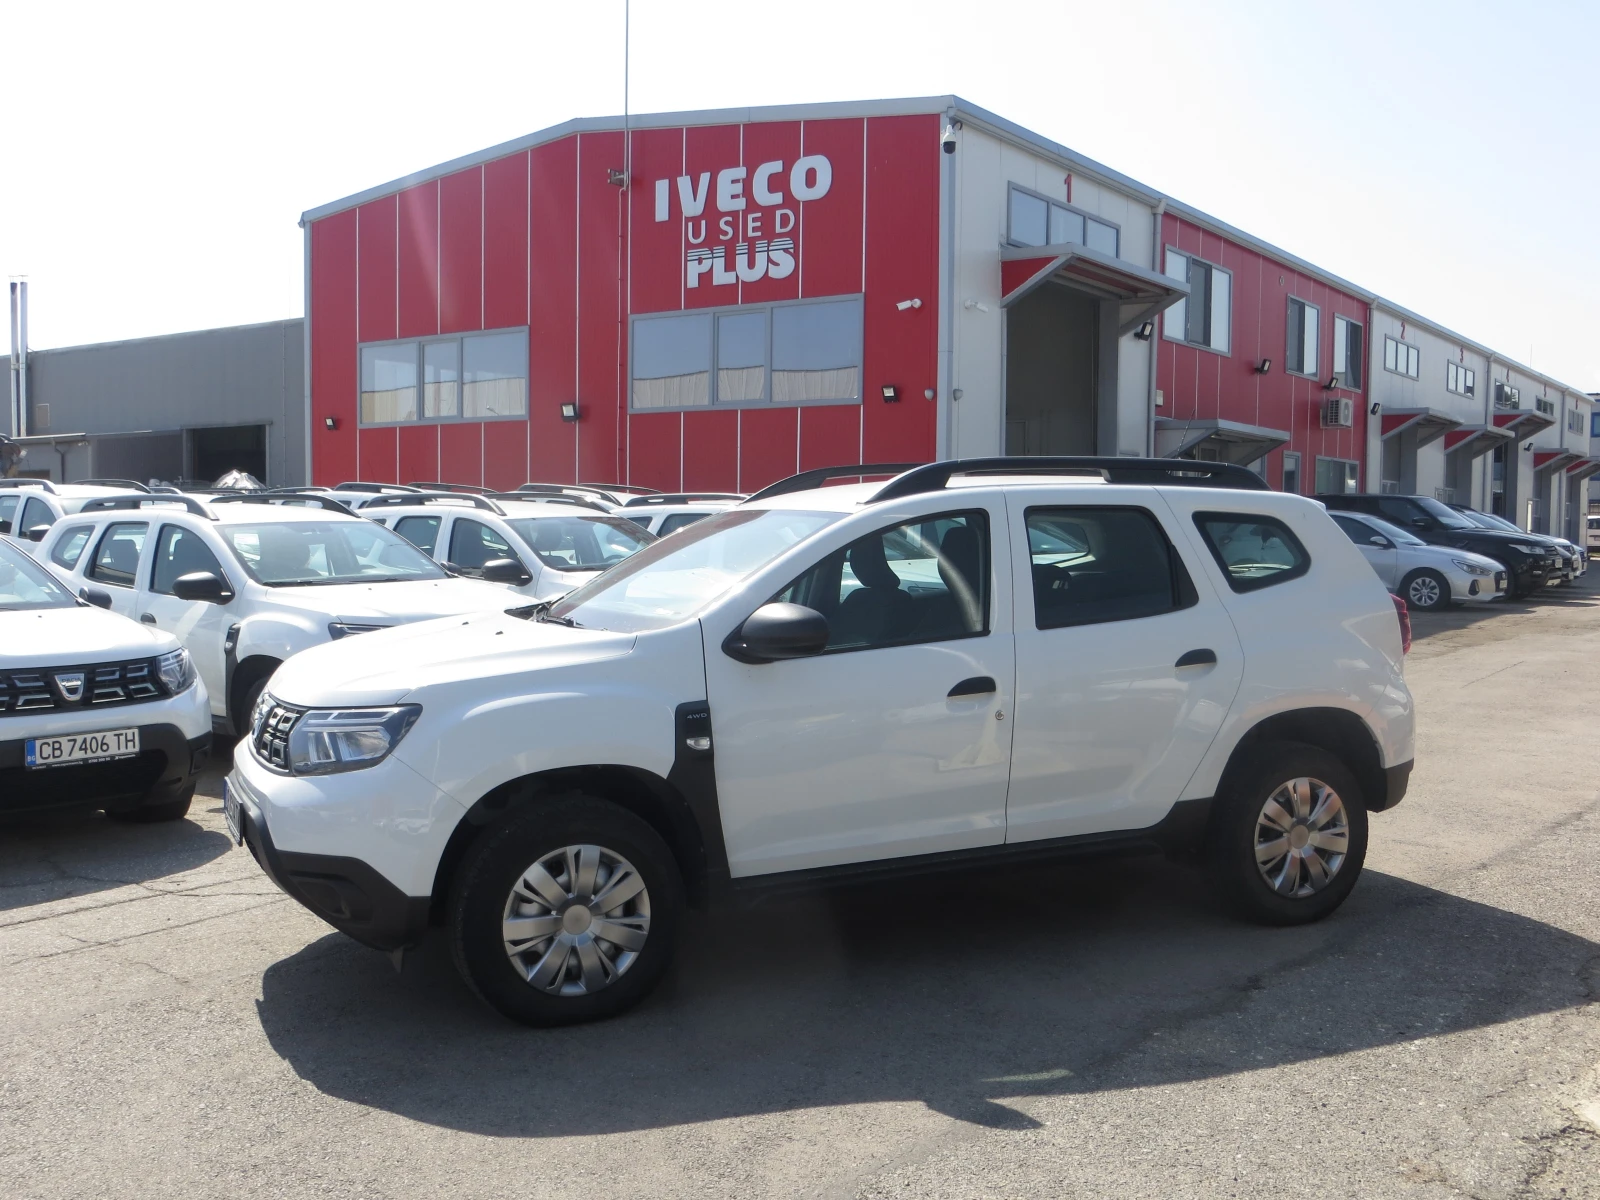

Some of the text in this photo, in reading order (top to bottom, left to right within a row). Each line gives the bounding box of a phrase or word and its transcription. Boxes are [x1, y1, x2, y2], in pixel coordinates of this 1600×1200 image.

[655, 154, 832, 223] IVECO
[1064, 173, 1072, 204] 1
[687, 208, 796, 245] USED
[687, 237, 796, 289] PLUS
[1400, 321, 1406, 341] 2
[39, 731, 136, 760] CB 7406 TH
